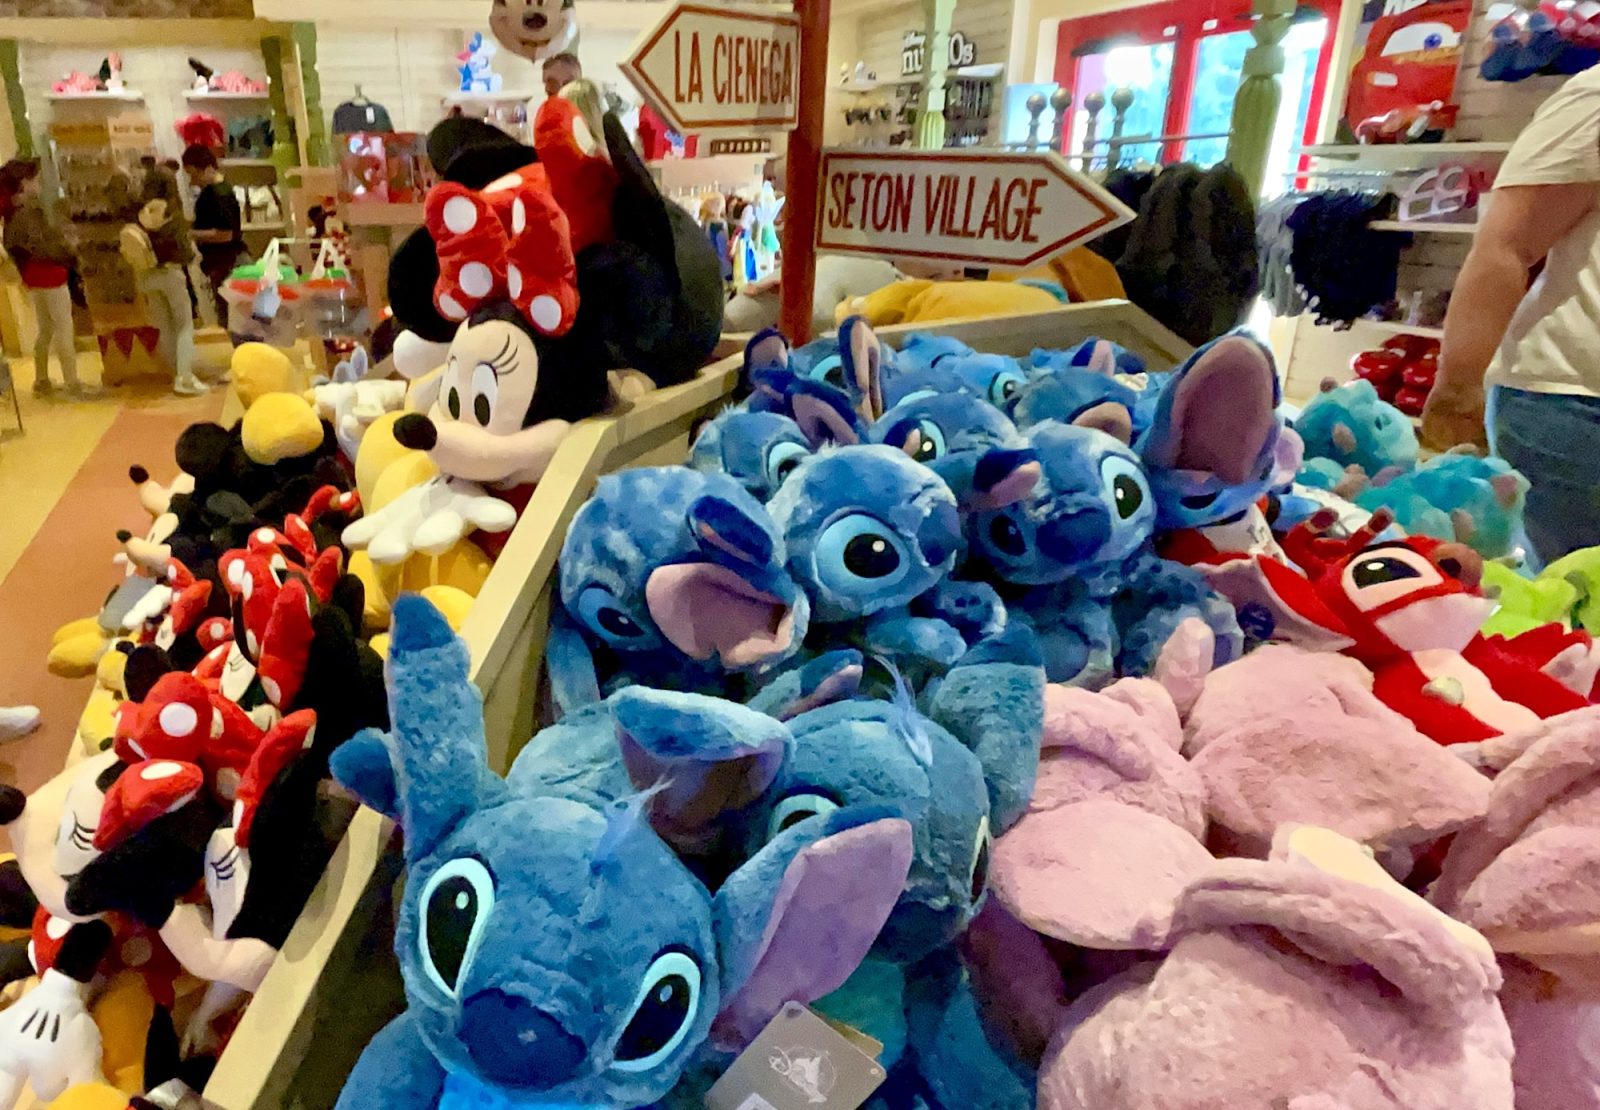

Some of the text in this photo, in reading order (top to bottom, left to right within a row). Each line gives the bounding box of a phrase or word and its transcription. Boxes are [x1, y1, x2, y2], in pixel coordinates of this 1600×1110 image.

[675, 31, 792, 104] LA CIENEGA
[828, 172, 1048, 243] SETON VILLAGE
